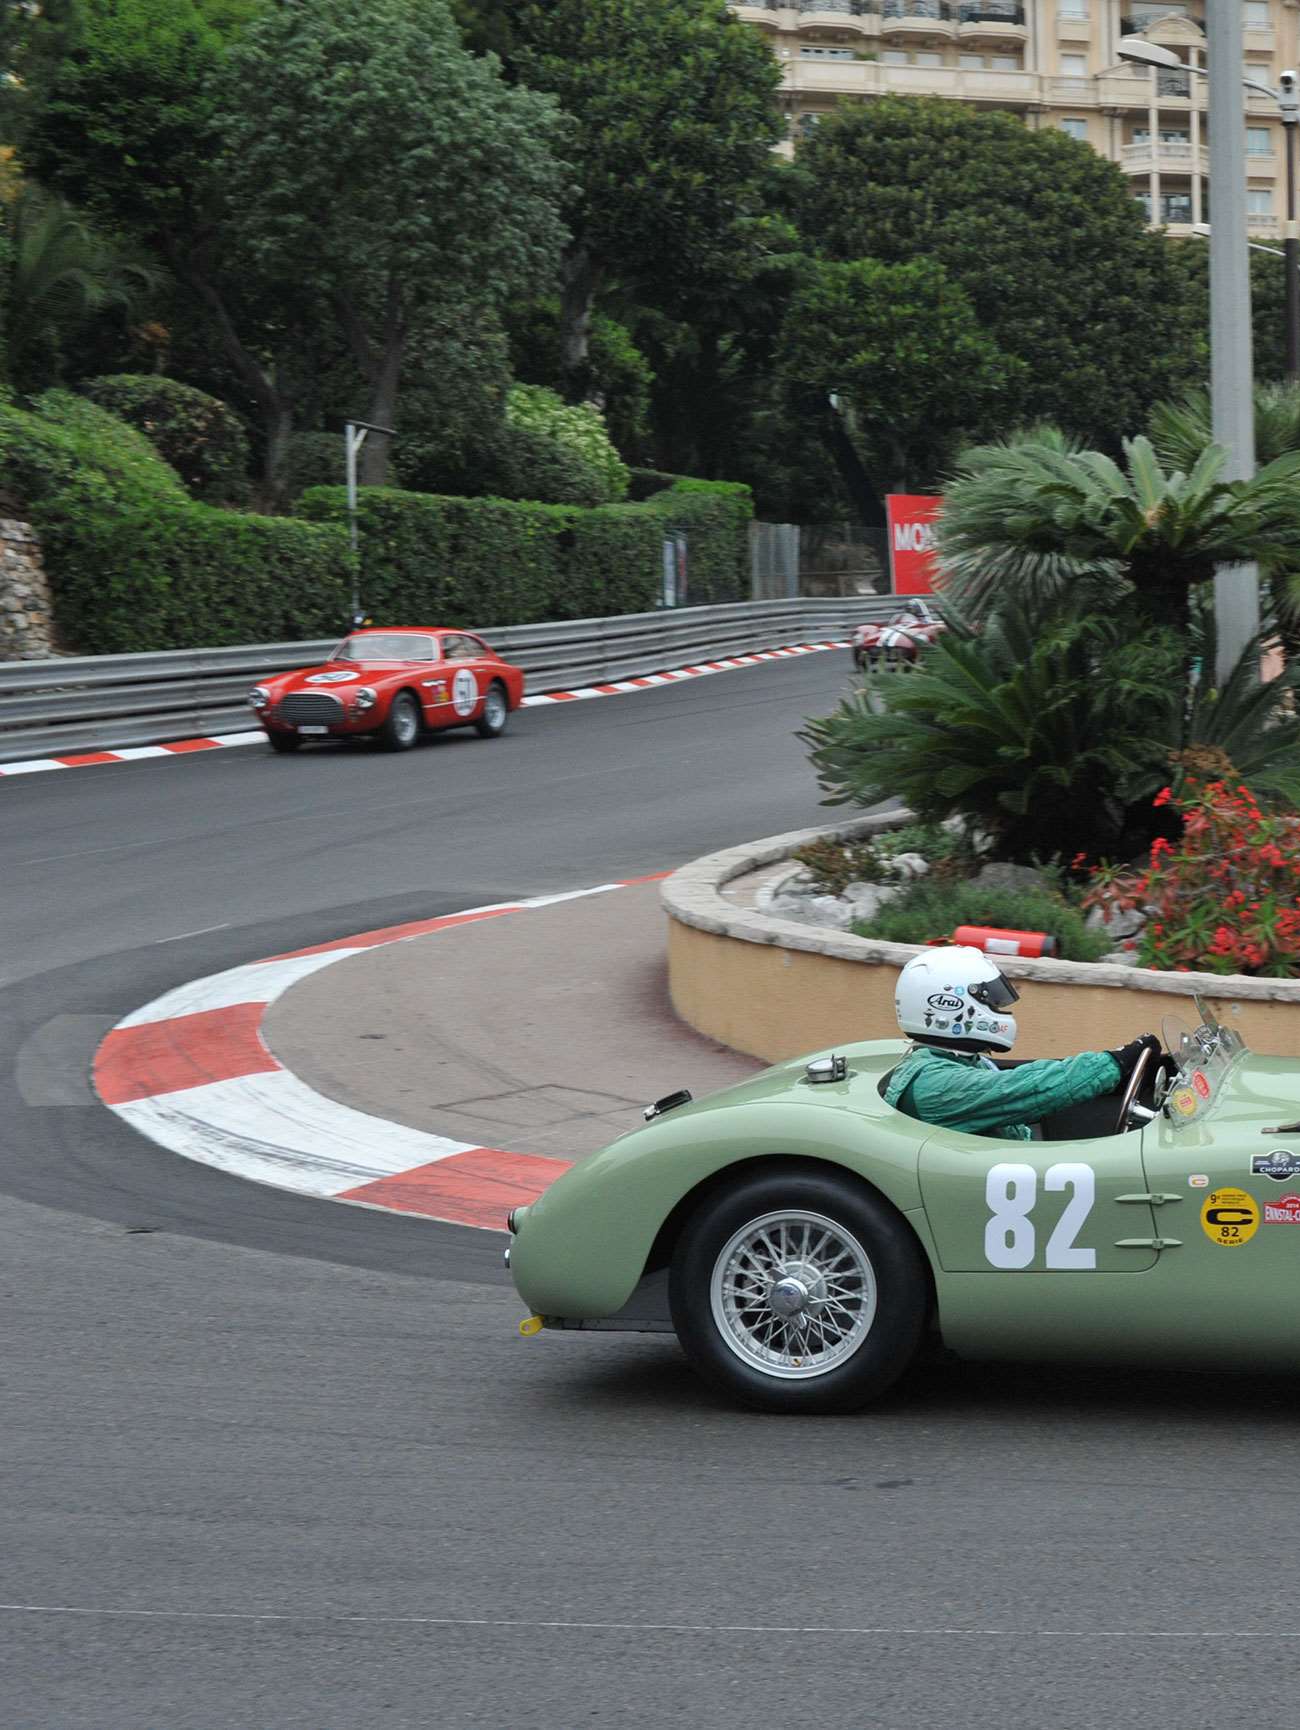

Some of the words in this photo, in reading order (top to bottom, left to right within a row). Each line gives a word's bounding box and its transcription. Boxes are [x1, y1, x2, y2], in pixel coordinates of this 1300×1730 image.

[931, 995, 960, 1008] Arai
[984, 1162, 1097, 1269] 82
[1221, 1226, 1240, 1238] 82
